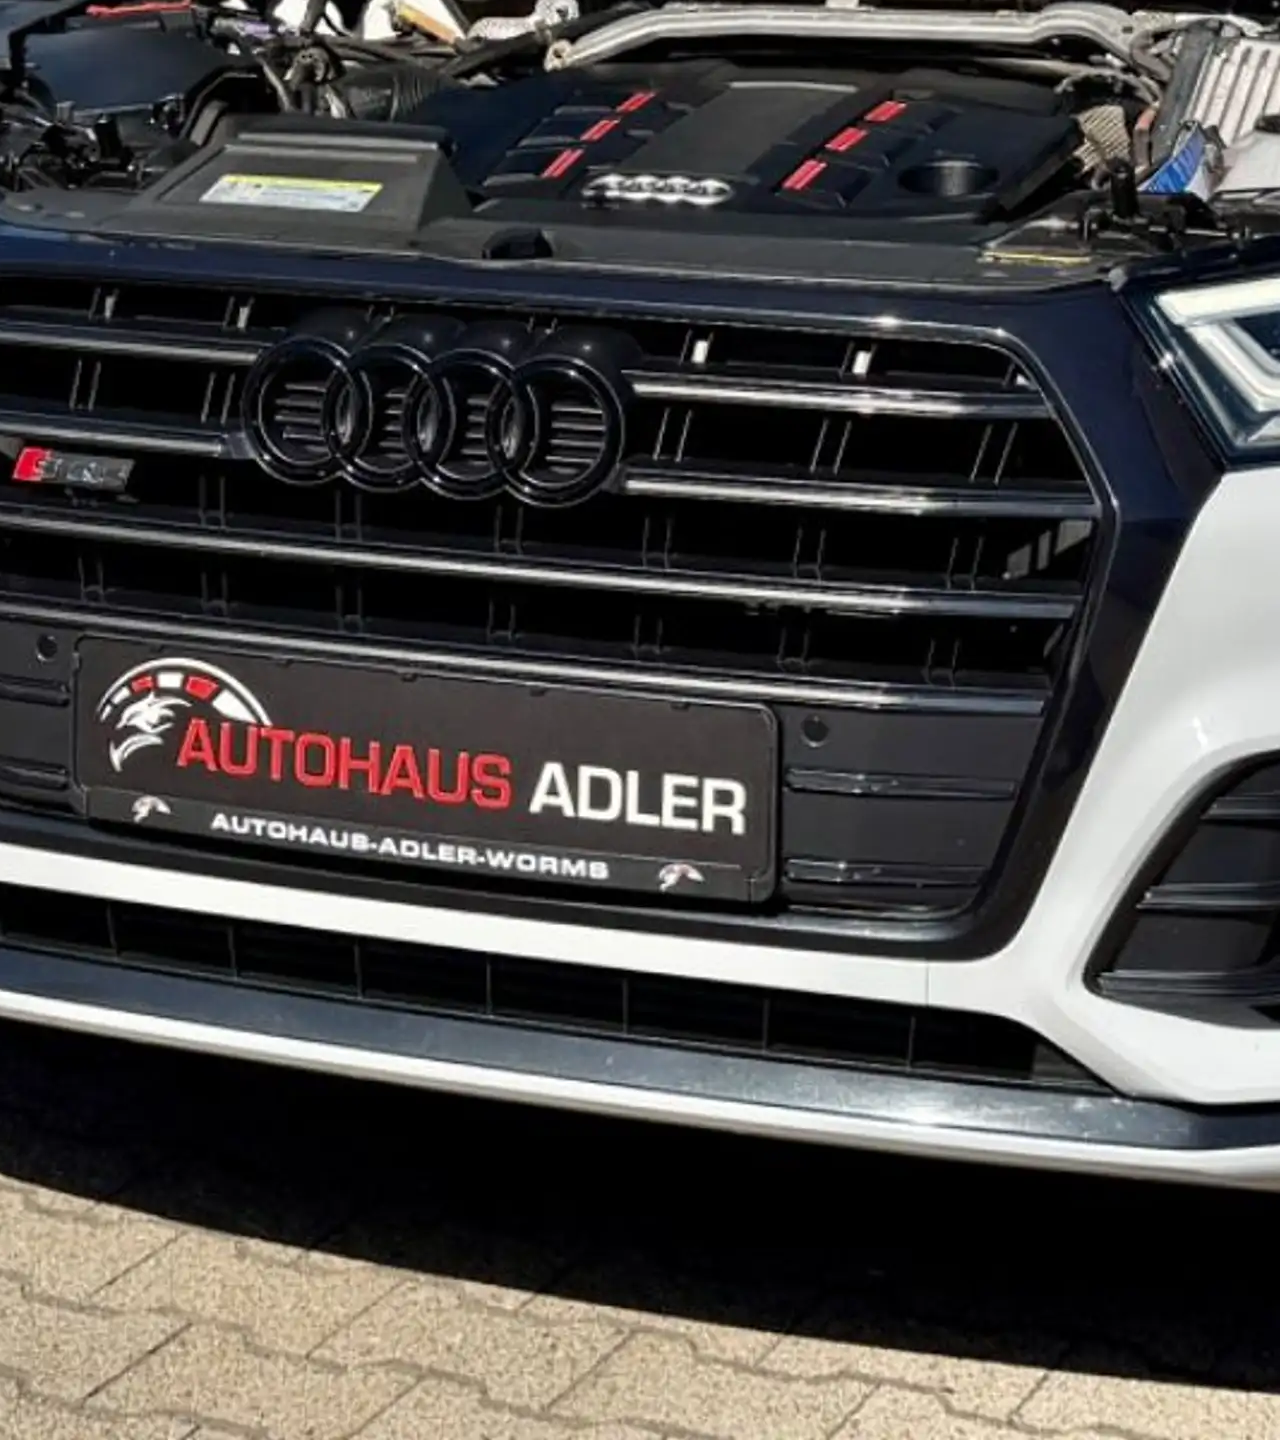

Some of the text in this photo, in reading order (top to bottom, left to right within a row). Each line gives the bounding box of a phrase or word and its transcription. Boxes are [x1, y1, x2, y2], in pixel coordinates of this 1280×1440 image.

[176, 718, 746, 835] AUTOHAUS ADLER
[210, 813, 610, 882] AUTOHAUS-ADLER-WORMS
